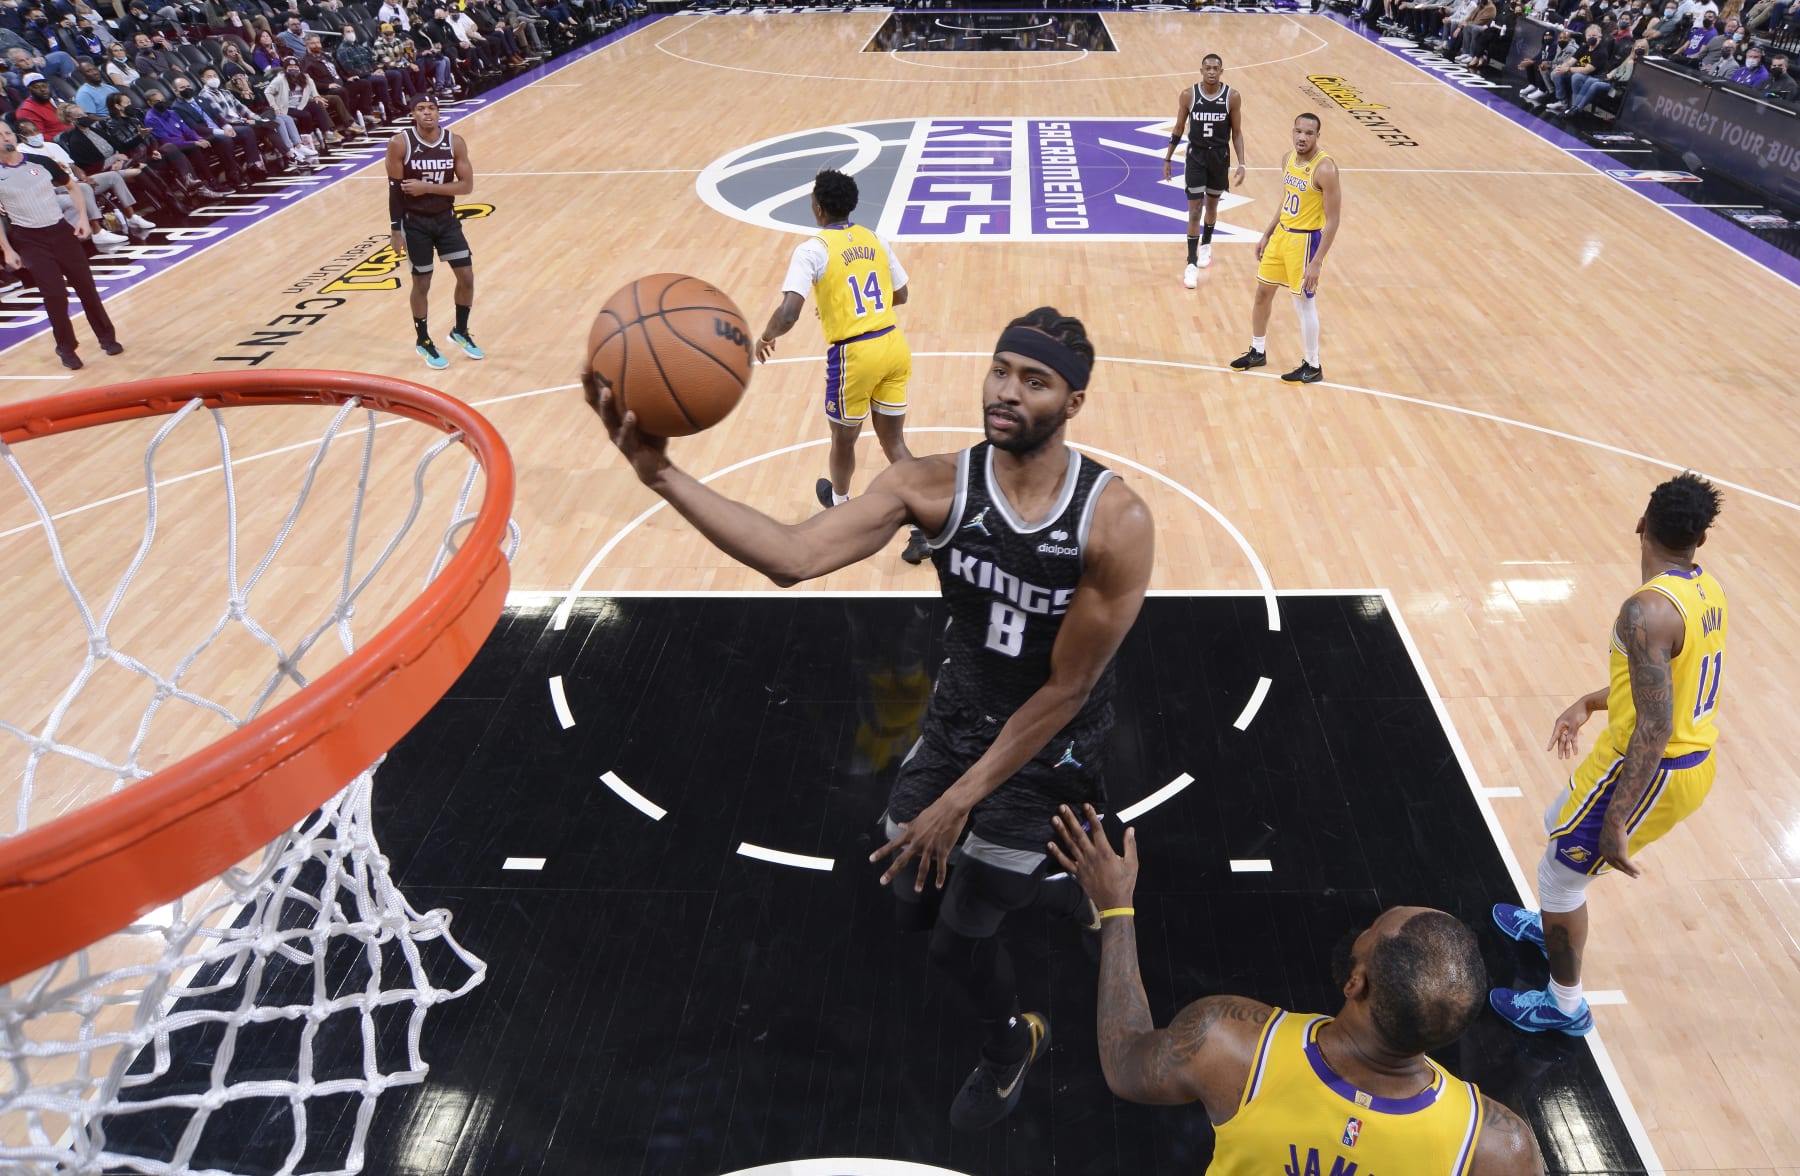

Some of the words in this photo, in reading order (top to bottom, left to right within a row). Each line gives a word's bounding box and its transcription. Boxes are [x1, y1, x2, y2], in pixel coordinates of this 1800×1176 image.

[1192, 112, 1228, 122] KINGS
[1203, 122, 1214, 138] 5
[1347, 109, 1419, 147] CENTER
[1654, 95, 1719, 135] PROTECT
[1720, 120, 1765, 156] YOUR
[410, 159, 454, 170] KINGS
[421, 171, 446, 184] 24
[896, 120, 1013, 235] KINGS
[1038, 121, 1090, 230] SACRAMENTO
[1283, 191, 1300, 216] 20
[841, 246, 876, 266] JOHNSON
[282, 264, 347, 294] Union
[848, 270, 884, 317] 14
[213, 298, 347, 367] CENT
[1037, 543, 1078, 556] dialpad
[950, 547, 1076, 615] KINGS
[985, 601, 1027, 657] 8
[1692, 649, 1723, 726] 11
[1284, 1143, 1375, 1176] JAM
